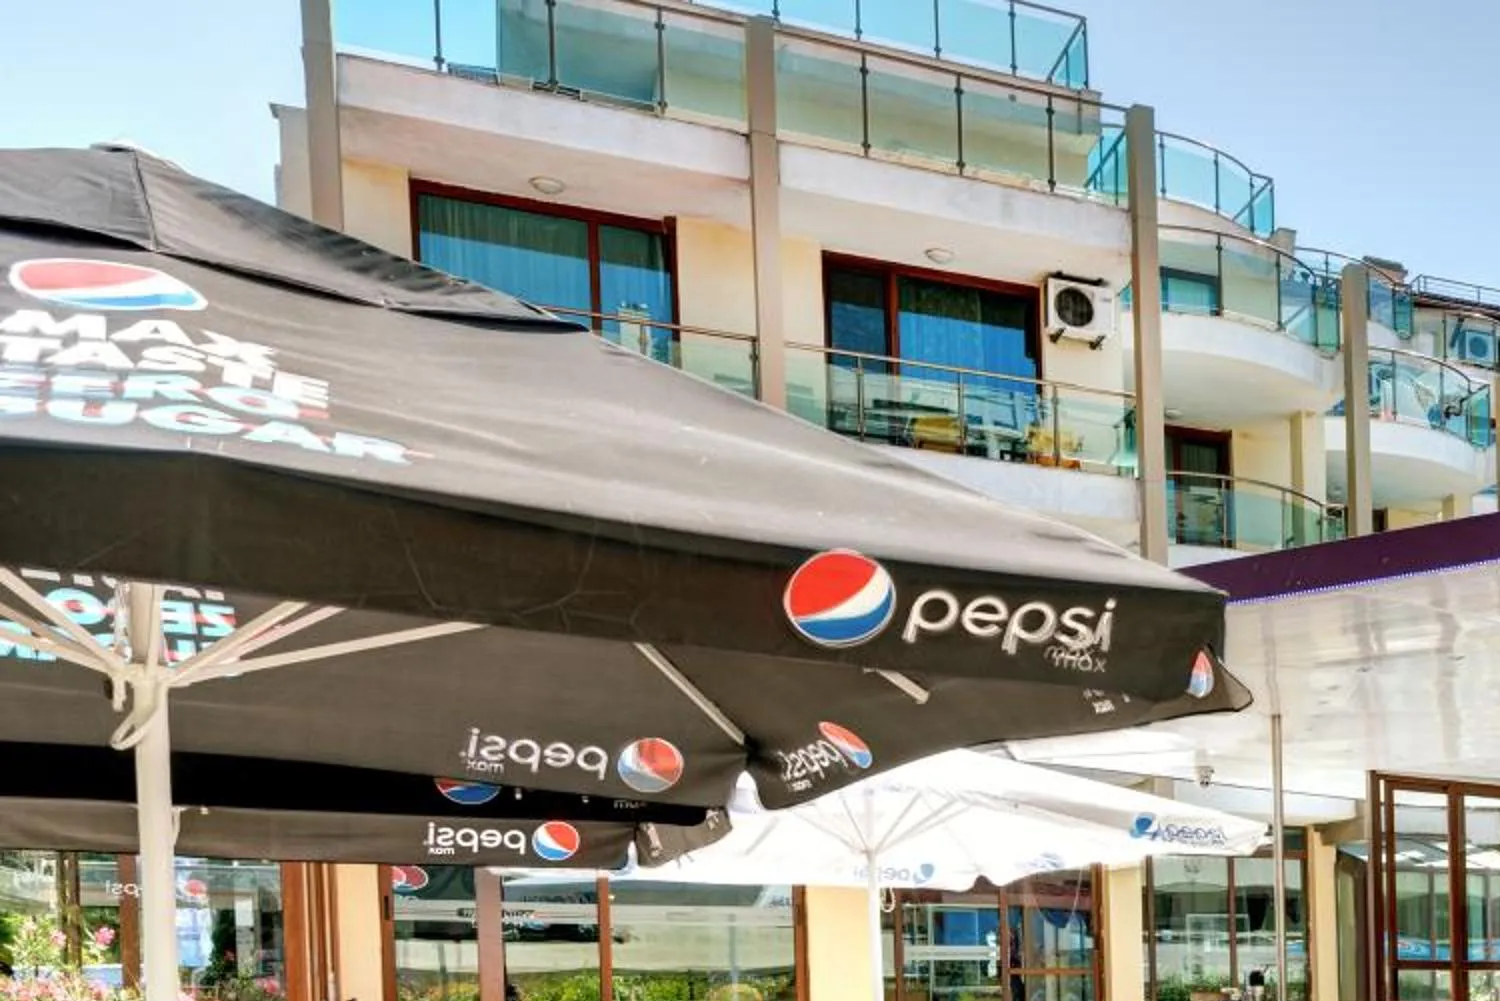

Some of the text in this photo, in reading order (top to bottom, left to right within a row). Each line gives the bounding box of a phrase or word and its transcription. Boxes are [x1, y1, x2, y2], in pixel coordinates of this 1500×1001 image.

[0, 309, 277, 365] MAX
[0, 335, 329, 409] TASTE
[902, 589, 1117, 655] pepsi
